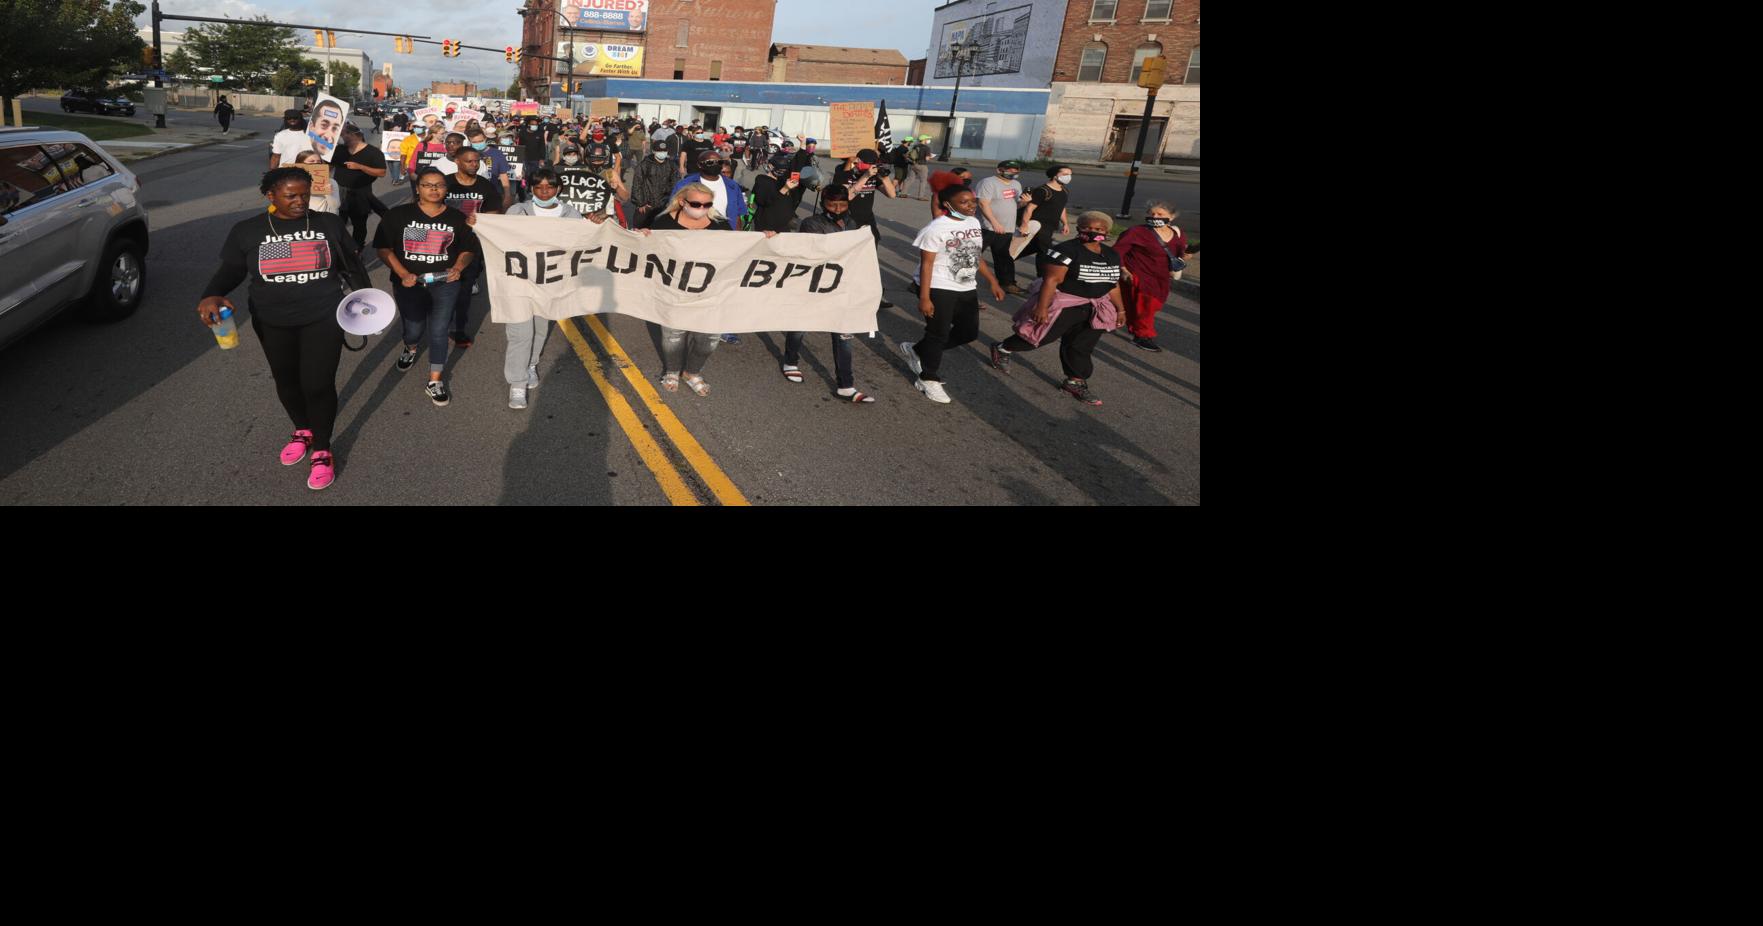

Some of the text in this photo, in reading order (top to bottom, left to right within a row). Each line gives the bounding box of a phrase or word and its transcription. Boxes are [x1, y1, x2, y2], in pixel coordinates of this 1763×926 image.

[607, 45, 634, 53] DREAM
[560, 175, 606, 190] BLACK
[446, 192, 484, 200] JustUs
[566, 200, 603, 214] ATTER
[407, 220, 454, 232] JustUs
[261, 230, 326, 245] JustUs
[404, 250, 449, 264] League
[504, 245, 844, 294] DEFUND BPD
[262, 270, 329, 284] League
